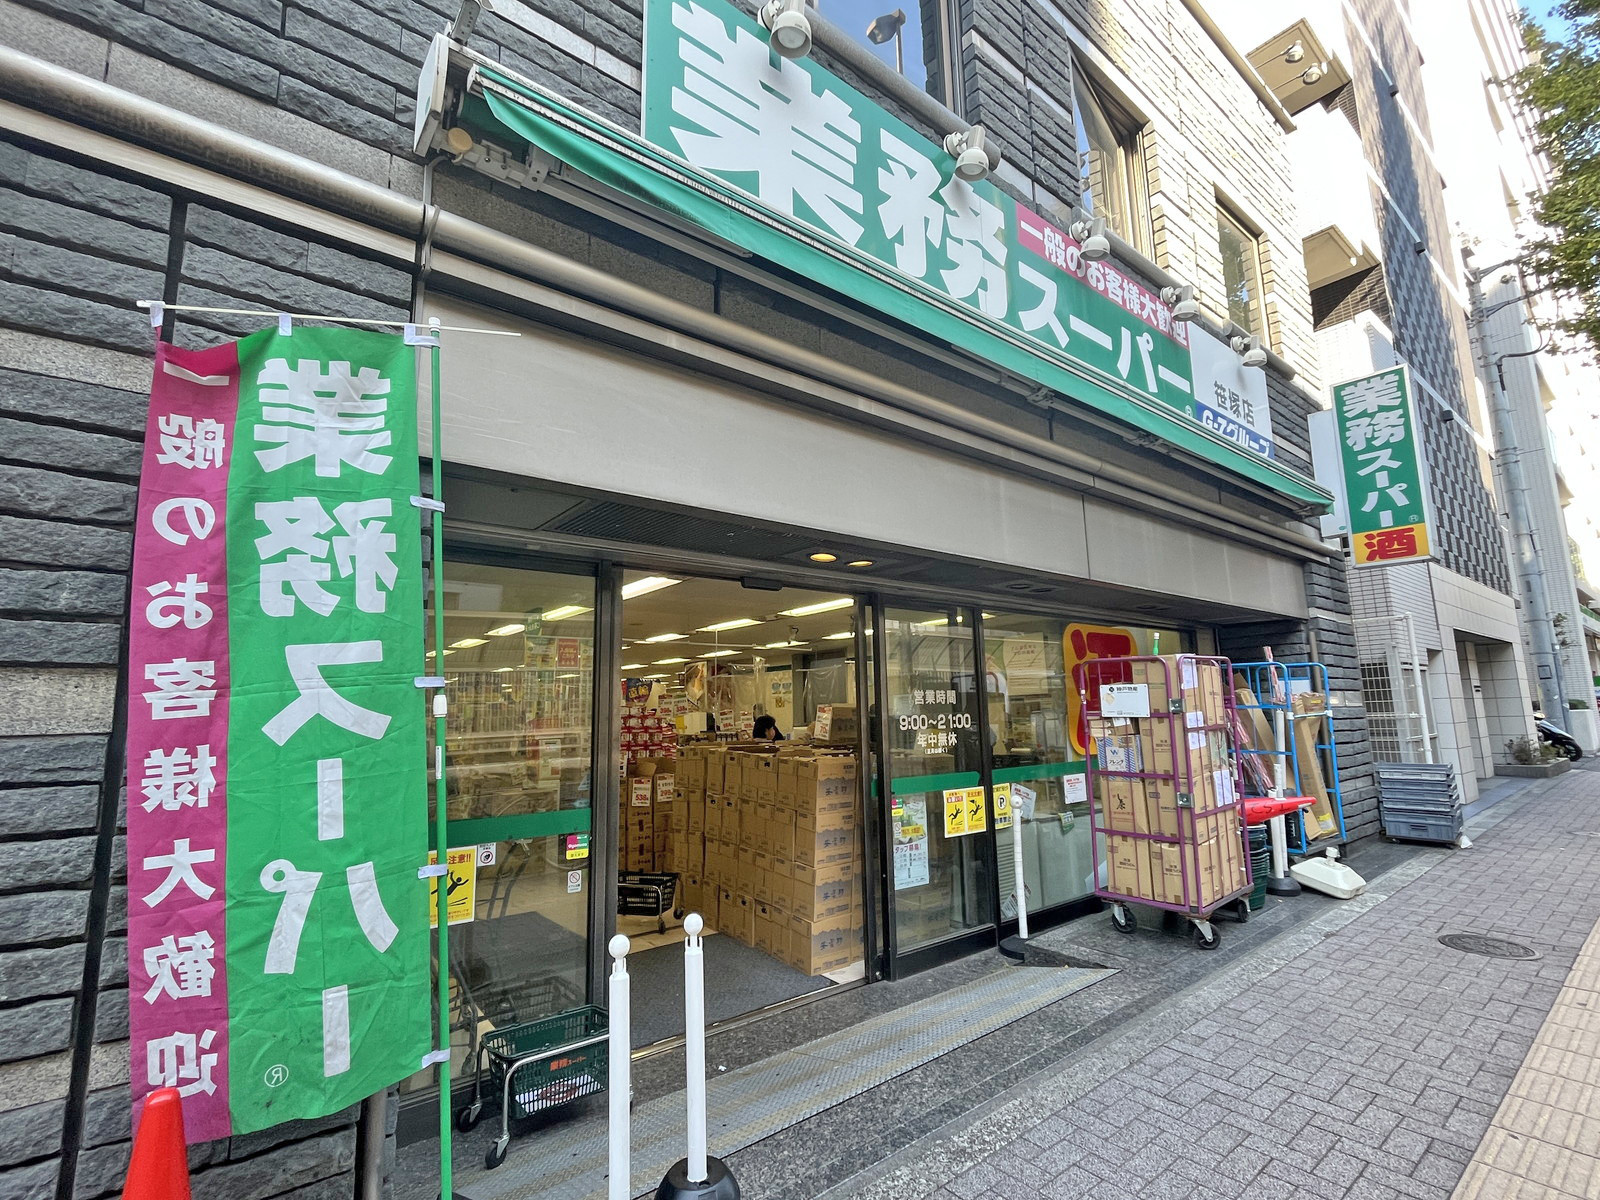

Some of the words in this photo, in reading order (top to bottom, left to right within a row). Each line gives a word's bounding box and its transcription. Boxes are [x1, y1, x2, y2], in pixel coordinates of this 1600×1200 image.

[670, 0, 1191, 394] 業務スーパー
[1020, 220, 1188, 347] 一般のお客様大歓迎
[1213, 380, 1255, 427] 笹塚店
[1340, 373, 1410, 528] 業務スーパー
[1364, 527, 1418, 562] 酒
[914, 690, 957, 705] 営業時間
[916, 732, 958, 748] 年中無休
